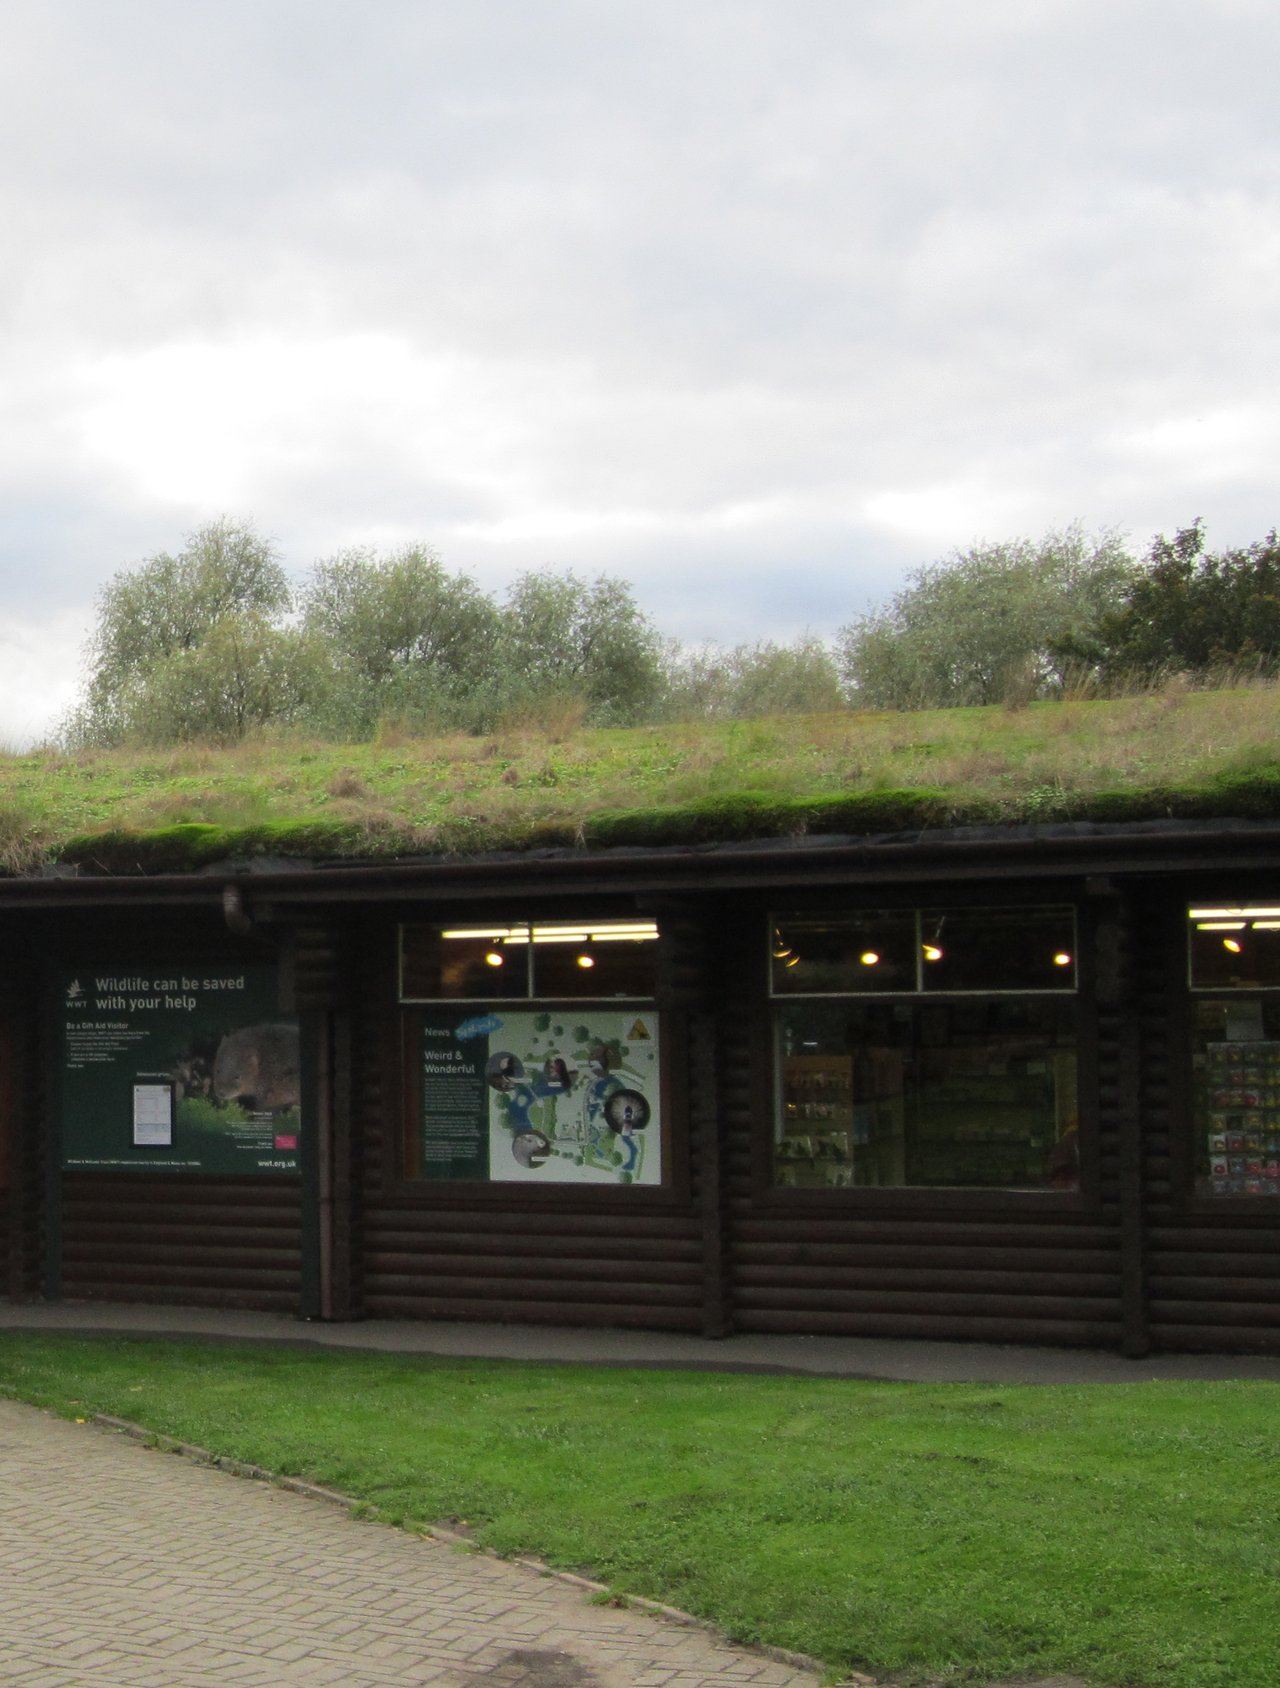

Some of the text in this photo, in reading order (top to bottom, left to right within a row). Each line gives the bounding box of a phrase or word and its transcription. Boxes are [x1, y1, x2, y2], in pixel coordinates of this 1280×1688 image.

[95, 976, 245, 991] Wildlife can be saved
[96, 995, 197, 1012] with your help
[81, 1022, 94, 1030] Gift
[95, 1022, 106, 1030] Aid
[107, 1022, 129, 1030] Visitor
[424, 1028, 450, 1037] News
[424, 1050, 463, 1061] Weird &
[424, 1063, 476, 1074] Wonderful
[257, 1159, 297, 1169] wwt.org.uk
